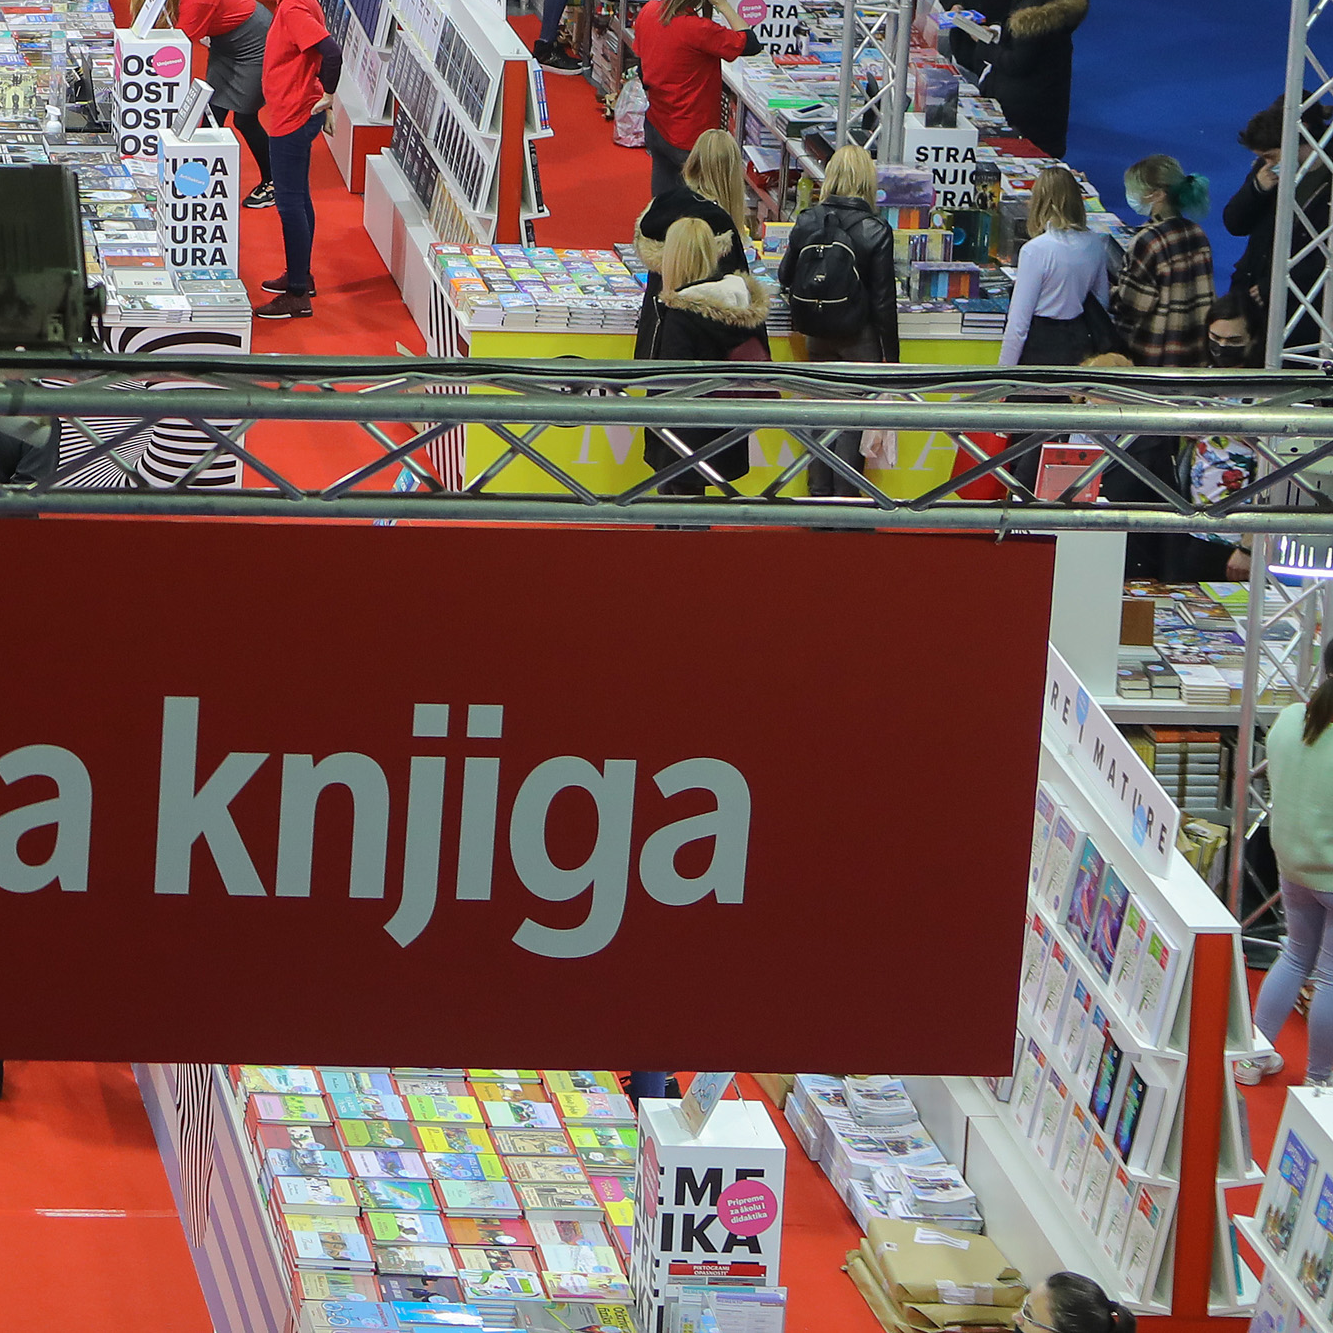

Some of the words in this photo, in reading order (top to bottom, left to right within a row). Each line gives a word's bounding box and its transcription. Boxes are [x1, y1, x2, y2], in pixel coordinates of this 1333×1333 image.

[741, 4, 762, 12] Strana
[743, 11, 762, 19] knjiga
[122, 81, 180, 104] OST
[1091, 736, 1169, 852] MATURE
[155, 696, 753, 960] knjiga
[726, 1194, 765, 1208] Pripreme
[740, 1204, 761, 1215] školu
[730, 1212, 768, 1225] didaktika
